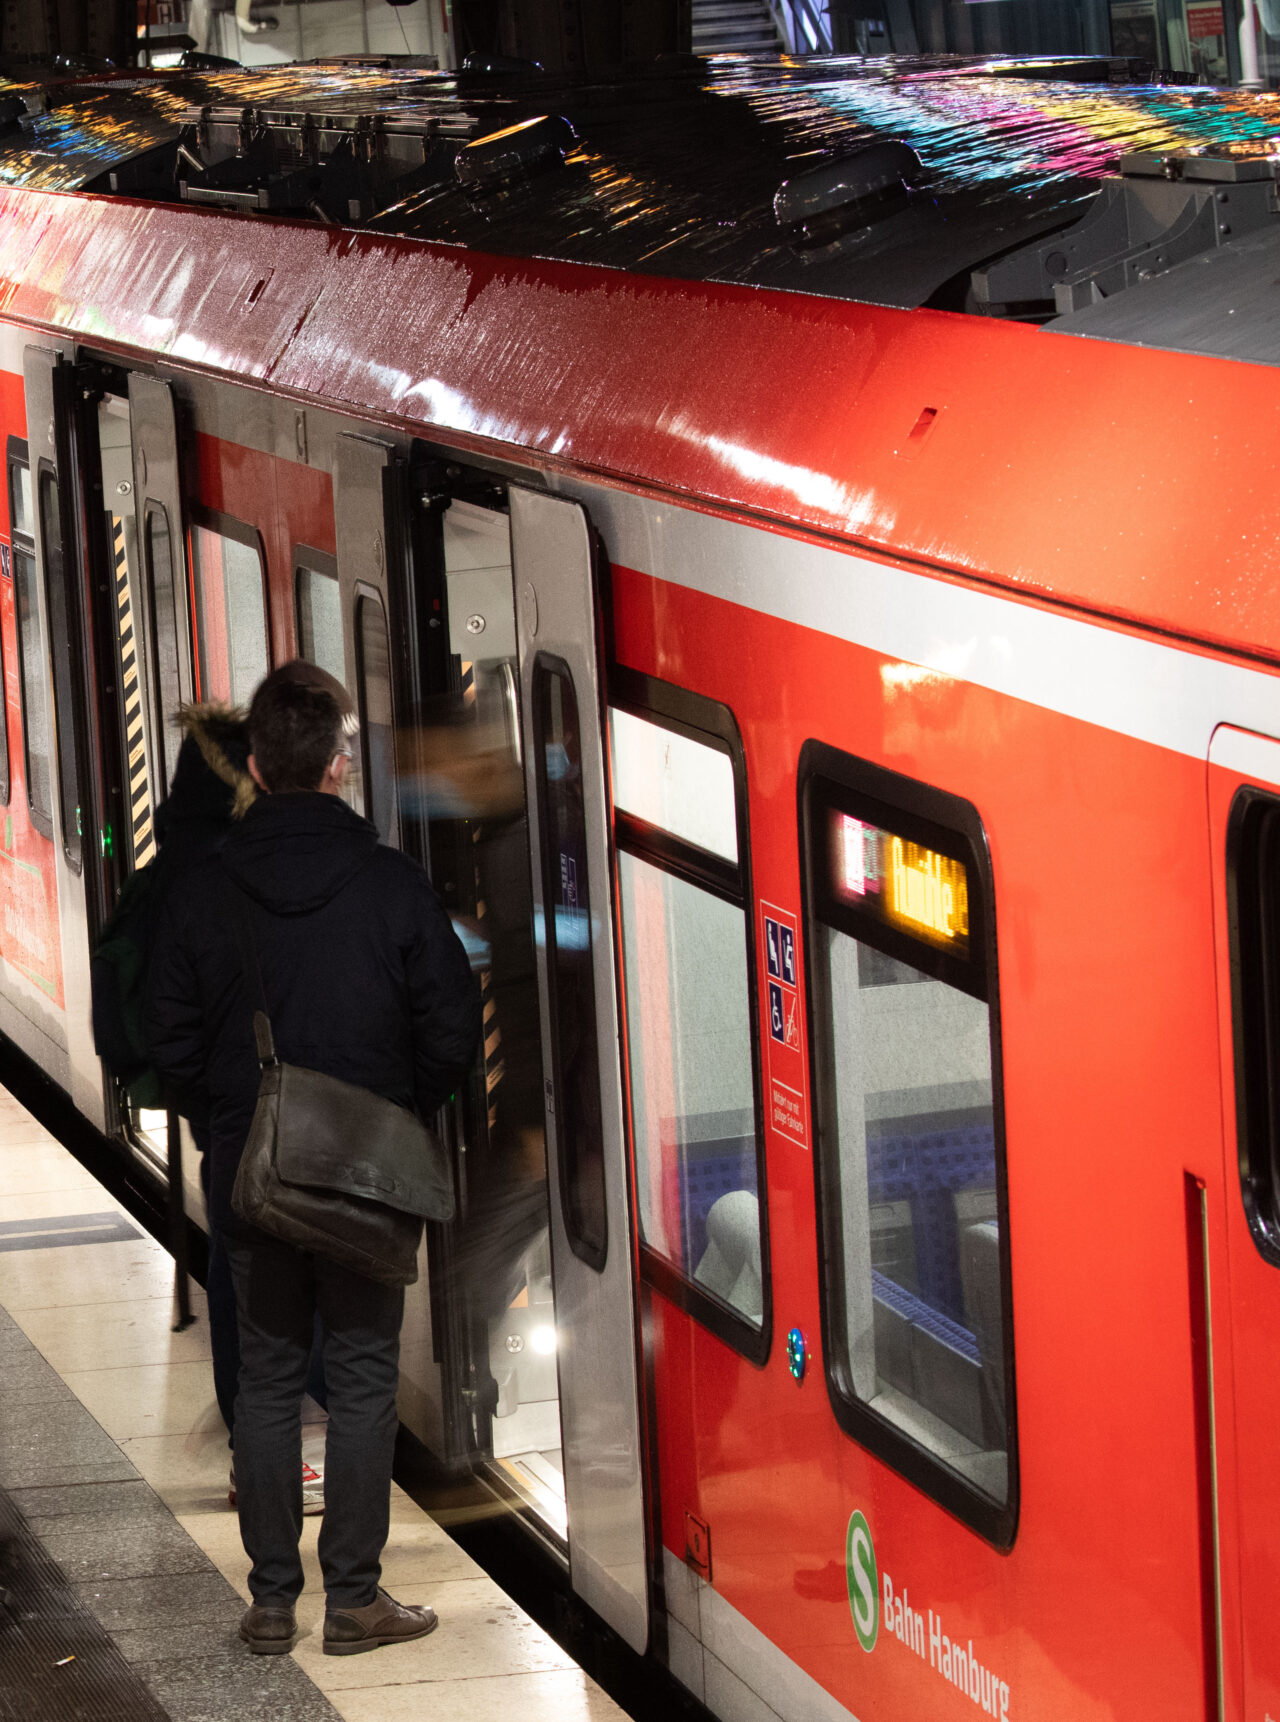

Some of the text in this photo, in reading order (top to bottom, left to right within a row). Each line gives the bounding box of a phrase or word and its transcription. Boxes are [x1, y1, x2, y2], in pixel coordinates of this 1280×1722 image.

[851, 1526, 1010, 1722] S Bahn Hamburg
